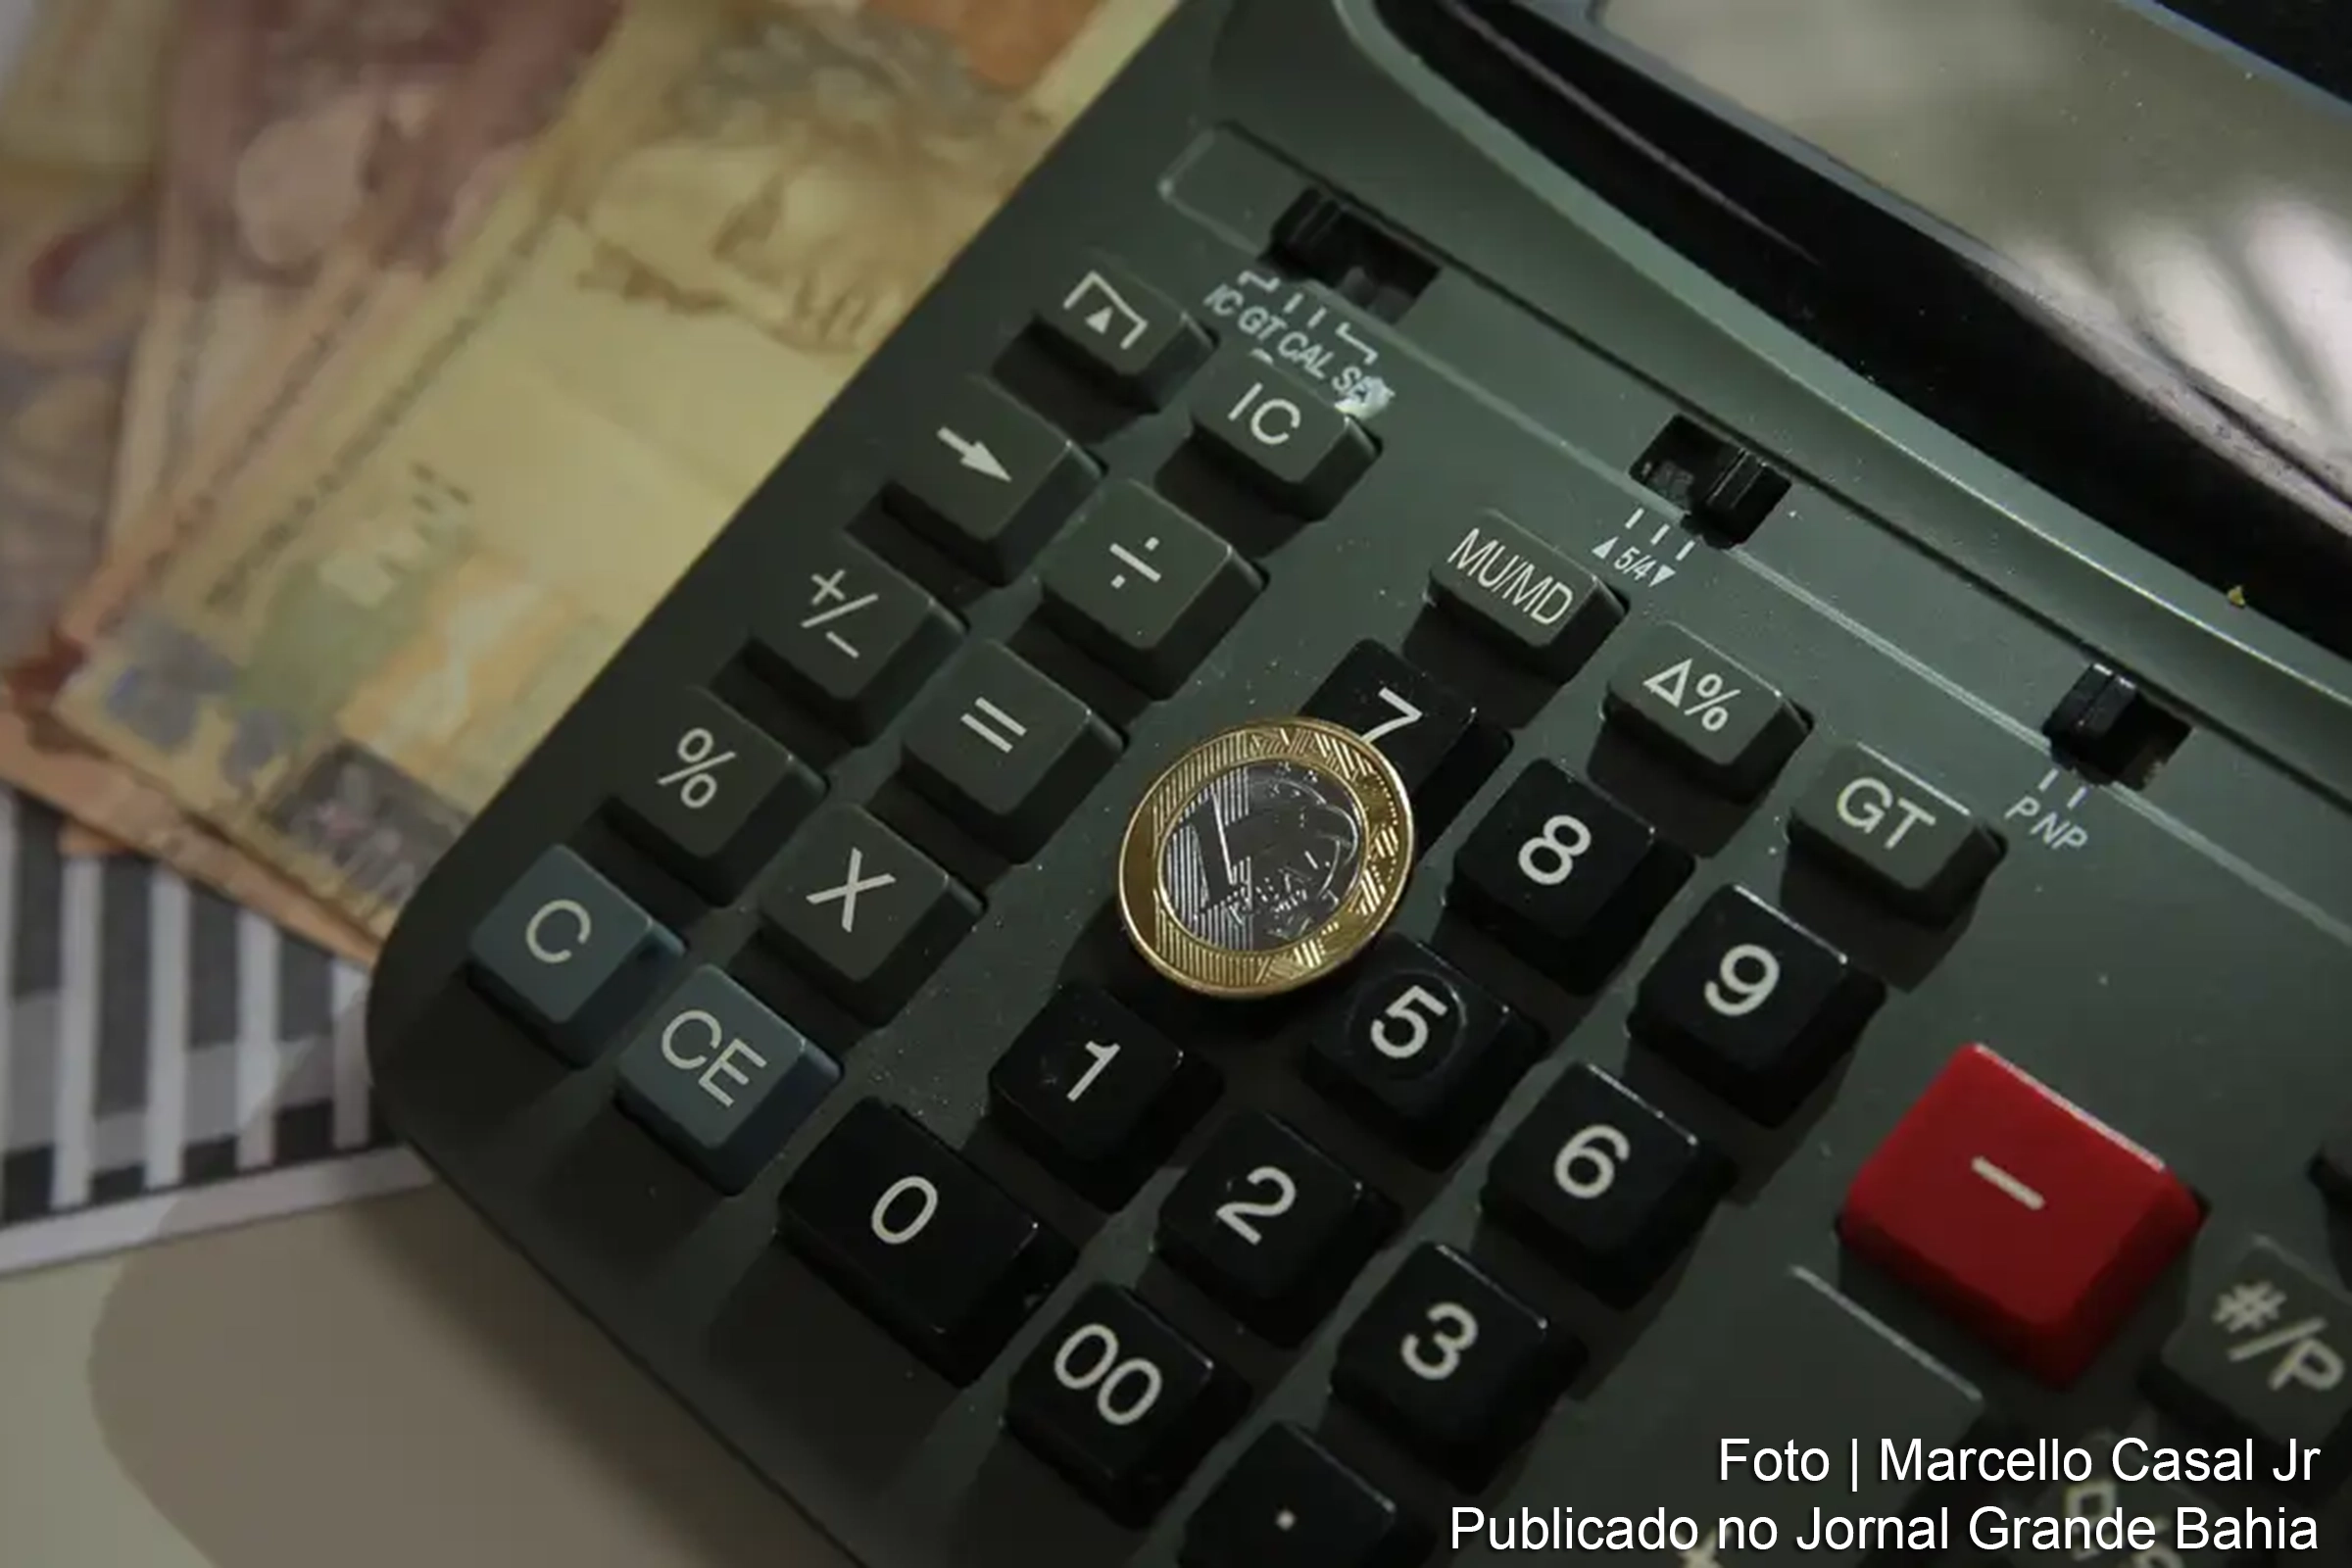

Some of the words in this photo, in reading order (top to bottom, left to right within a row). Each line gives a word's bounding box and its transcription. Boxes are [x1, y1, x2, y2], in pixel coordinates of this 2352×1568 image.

[1203, 283, 1245, 317] IC
[1238, 306, 1289, 340] GT
[1277, 331, 1334, 379] CAL
[1228, 382, 1301, 445] IC
[1446, 527, 1573, 625] MU/MD
[658, 727, 736, 808] %
[1837, 777, 1936, 851] GT
[2004, 795, 2041, 819] P
[1518, 814, 1592, 885] 8
[525, 899, 591, 963] C
[1704, 944, 1780, 1016] 9
[662, 1008, 767, 1107] CE
[1370, 984, 1447, 1058] 5
[1066, 1041, 1121, 1102] 1
[1554, 1124, 1630, 1200] 6
[870, 1175, 938, 1246] 0
[1215, 1166, 1297, 1246] 2
[1400, 1302, 1479, 1381] 3
[2212, 1280, 2344, 1392] #/P
[1054, 1323, 1162, 1426] 00
